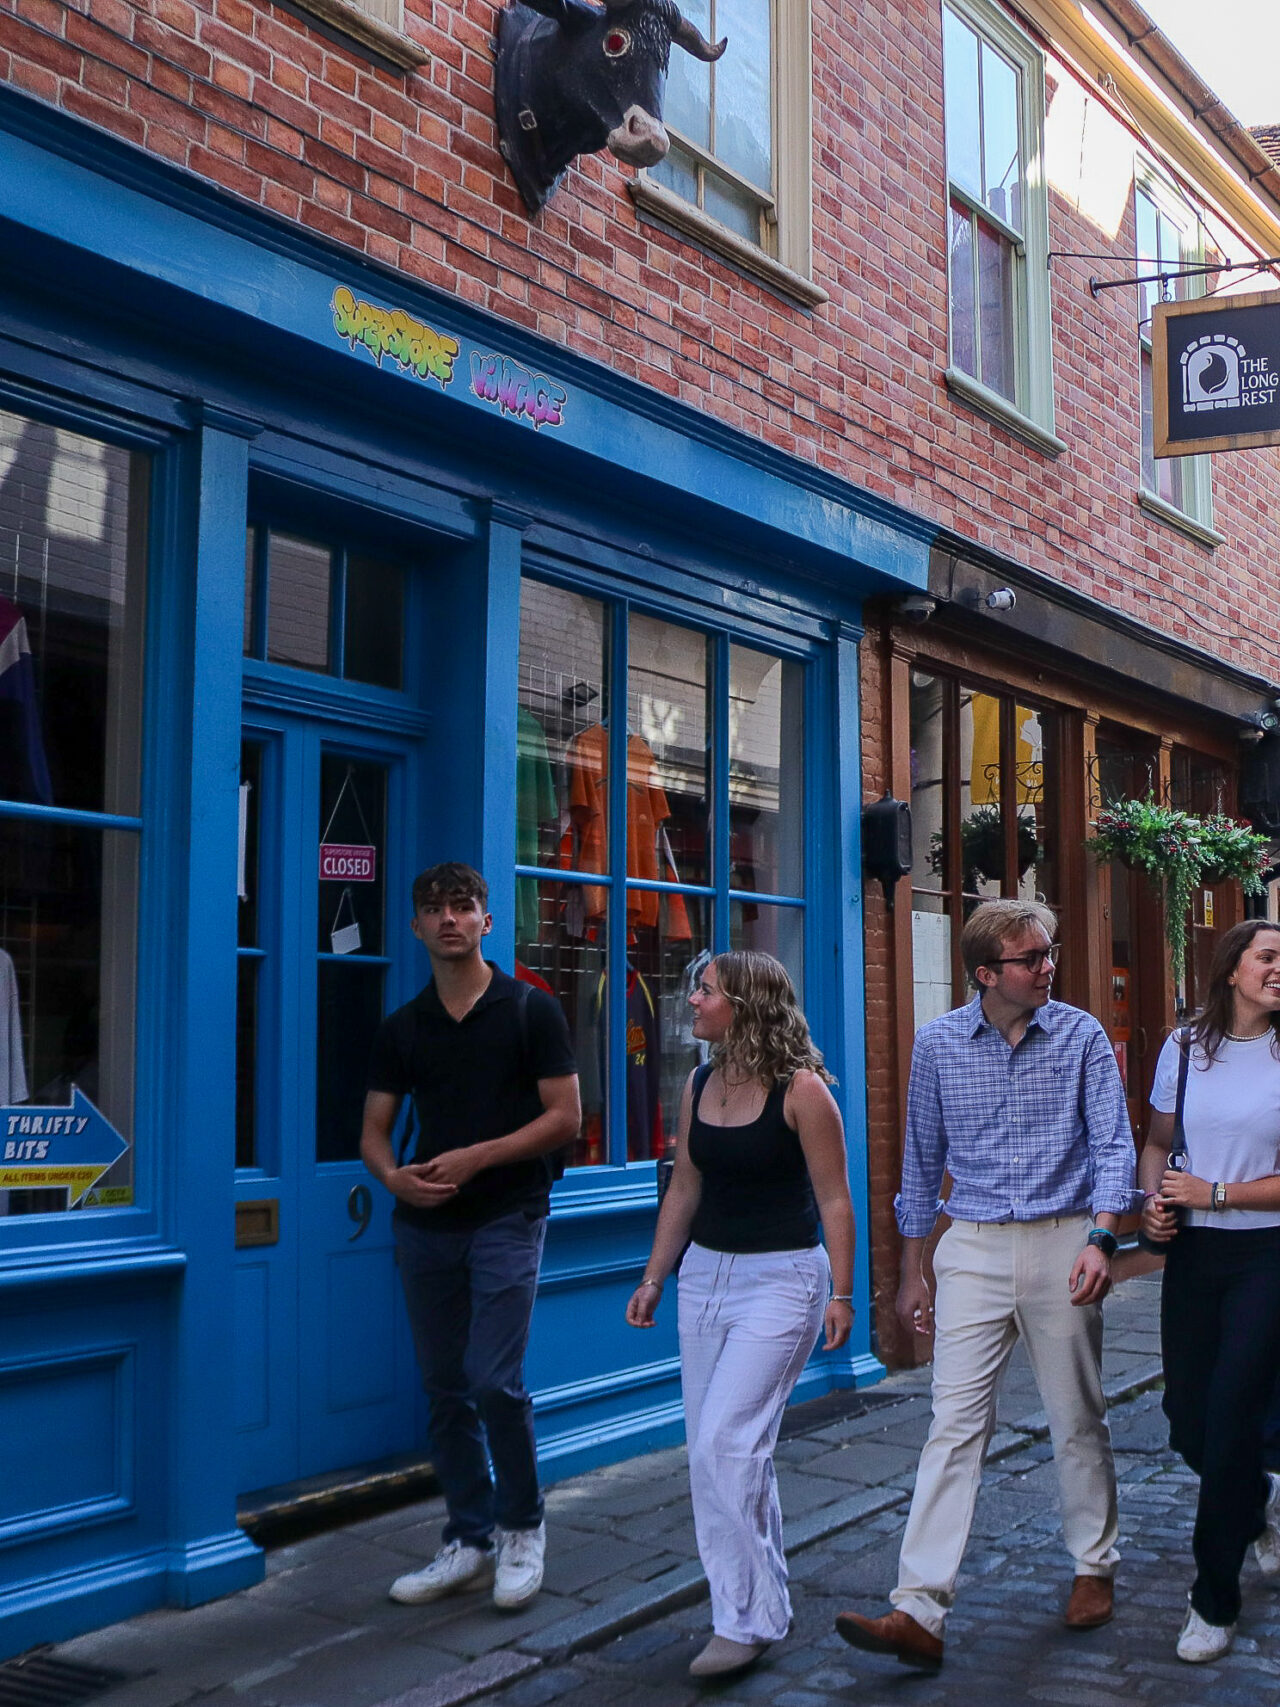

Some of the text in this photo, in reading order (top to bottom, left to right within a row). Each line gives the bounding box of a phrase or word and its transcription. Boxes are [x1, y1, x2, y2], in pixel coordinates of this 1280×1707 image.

[332, 285, 567, 431] SUPERSTORE VINTAGE
[1240, 357, 1269, 374] THE
[1241, 372, 1279, 390] LONG
[1241, 389, 1277, 407] REST
[323, 857, 370, 876] CLOSED
[7, 1115, 88, 1136] THRIFTY
[4, 1140, 49, 1160] BITS
[3, 1173, 19, 1182] ALL
[348, 1184, 372, 1242] 9
